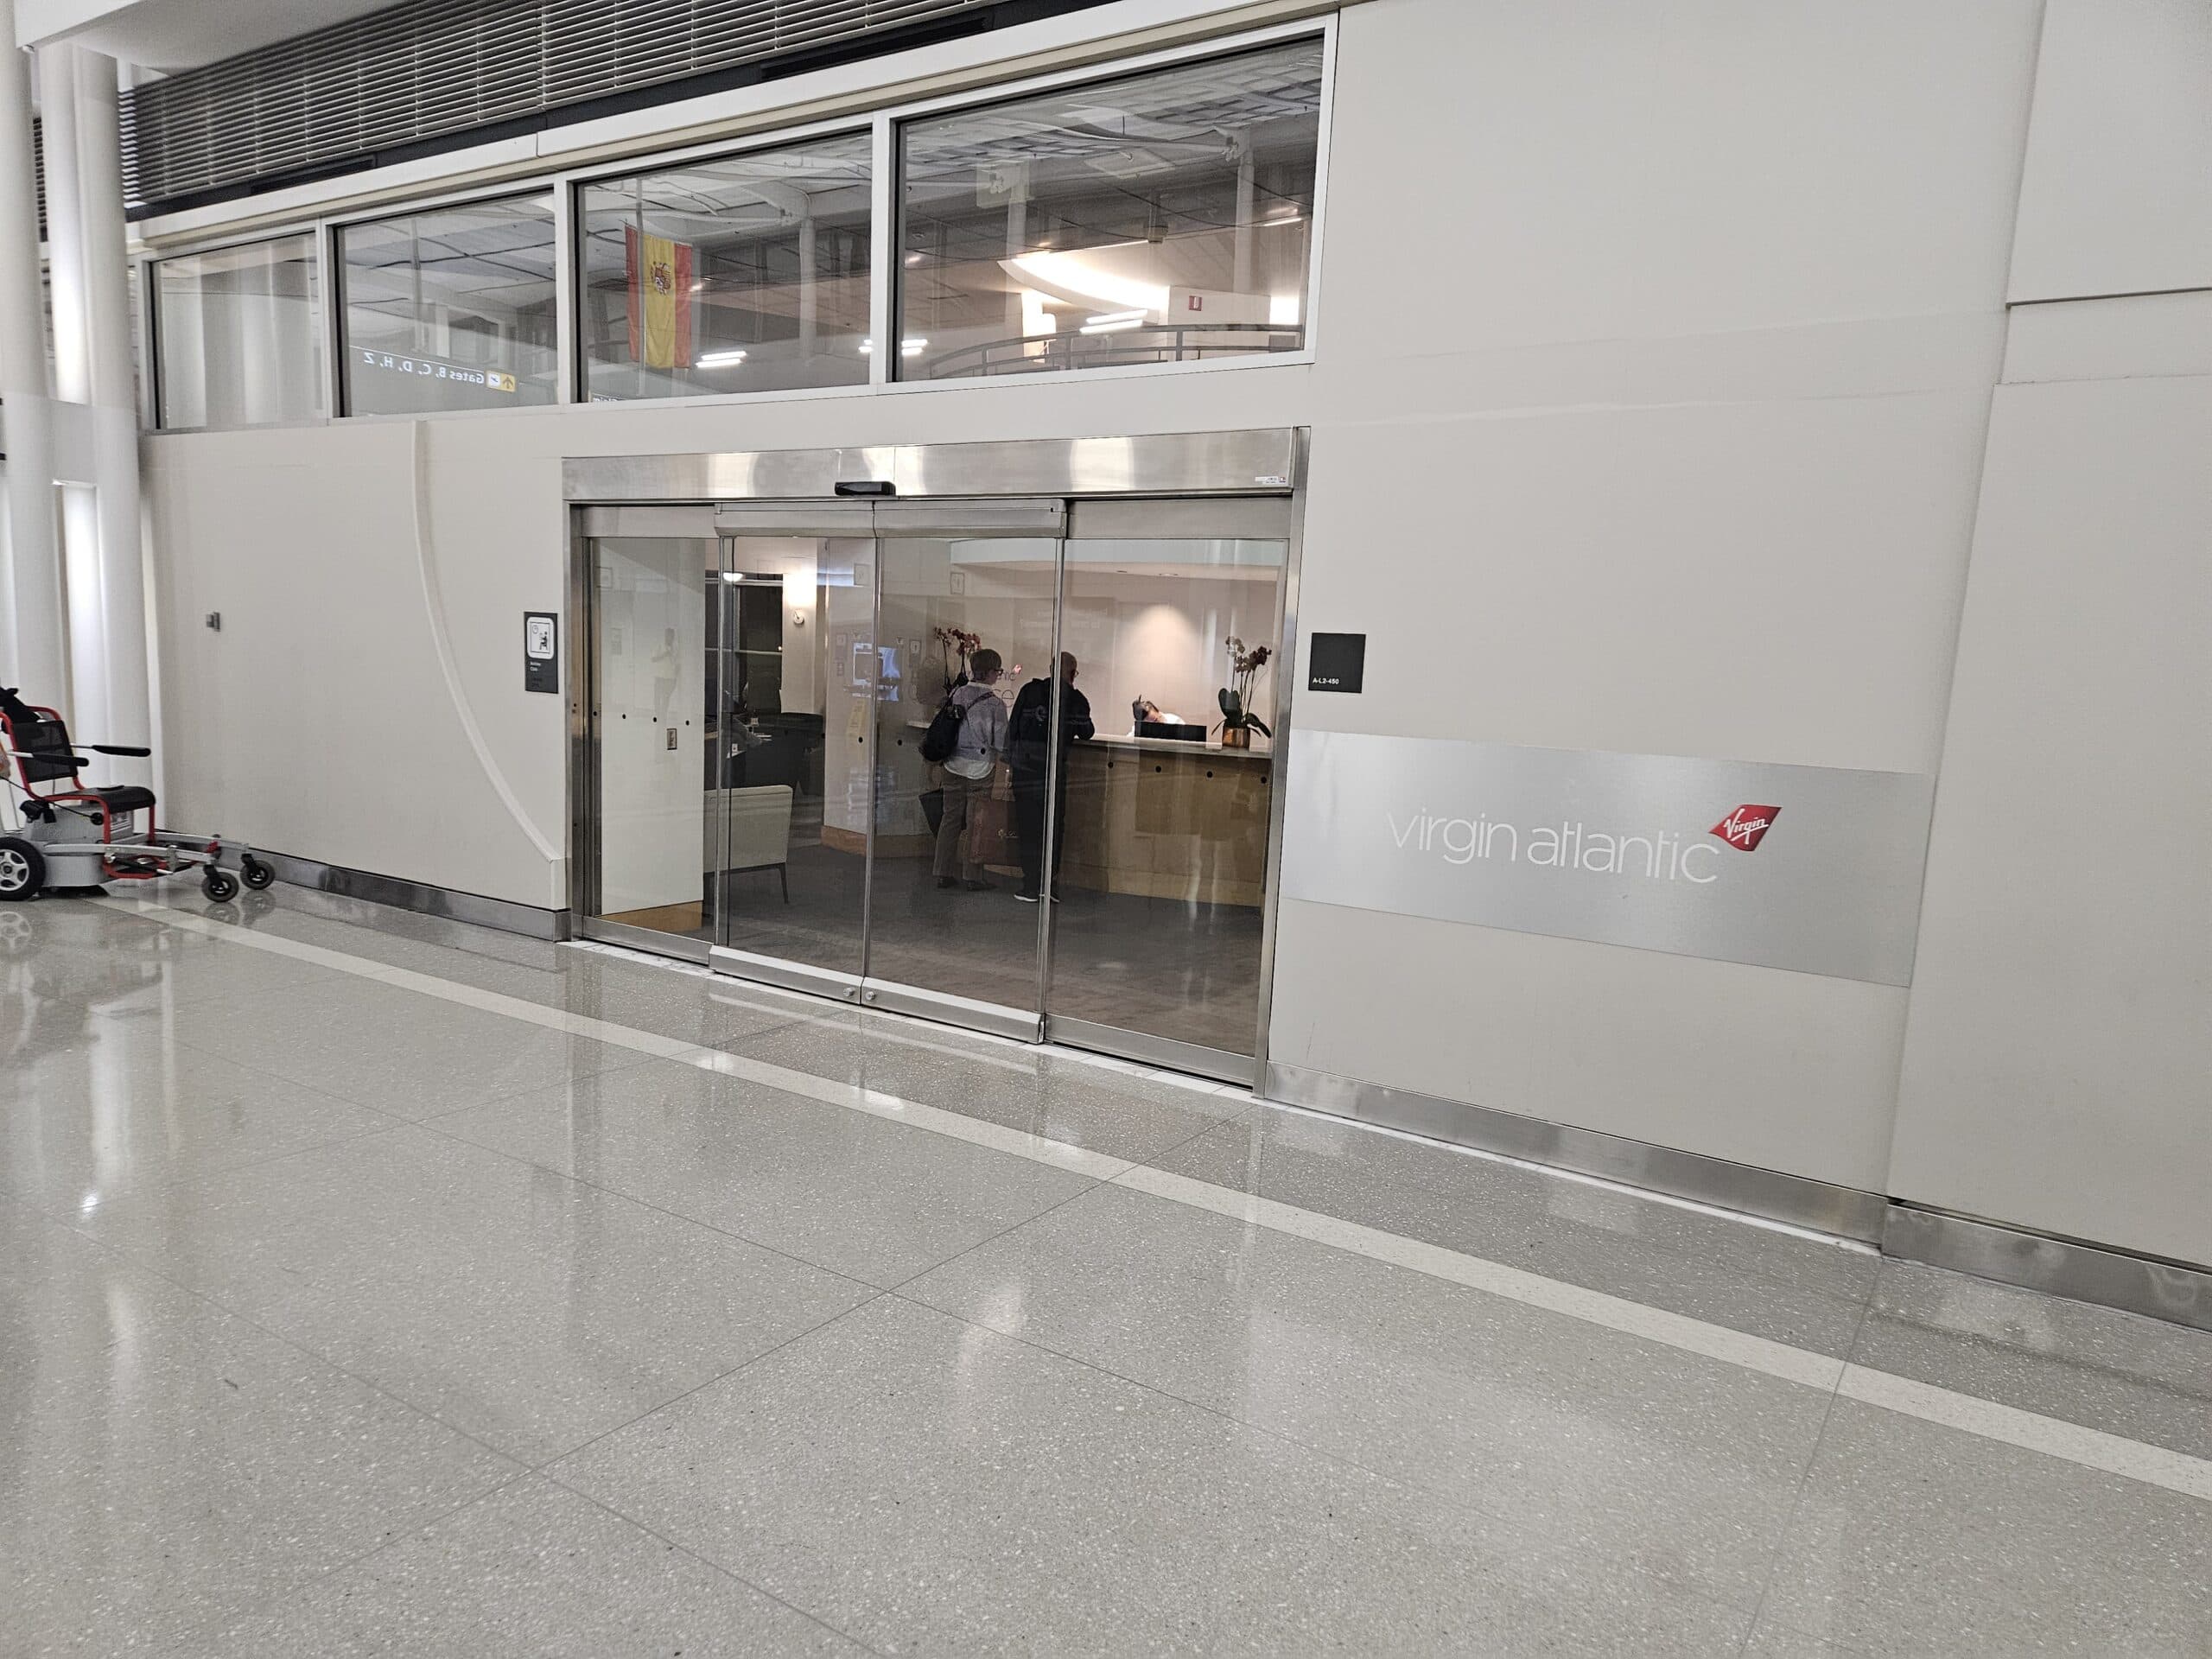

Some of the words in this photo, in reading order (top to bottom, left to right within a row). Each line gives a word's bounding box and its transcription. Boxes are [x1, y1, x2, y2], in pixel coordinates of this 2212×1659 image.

[1386, 807, 1518, 864] virgin
[1527, 821, 1721, 884] atlantic
[1723, 808, 1768, 844] Virgin
